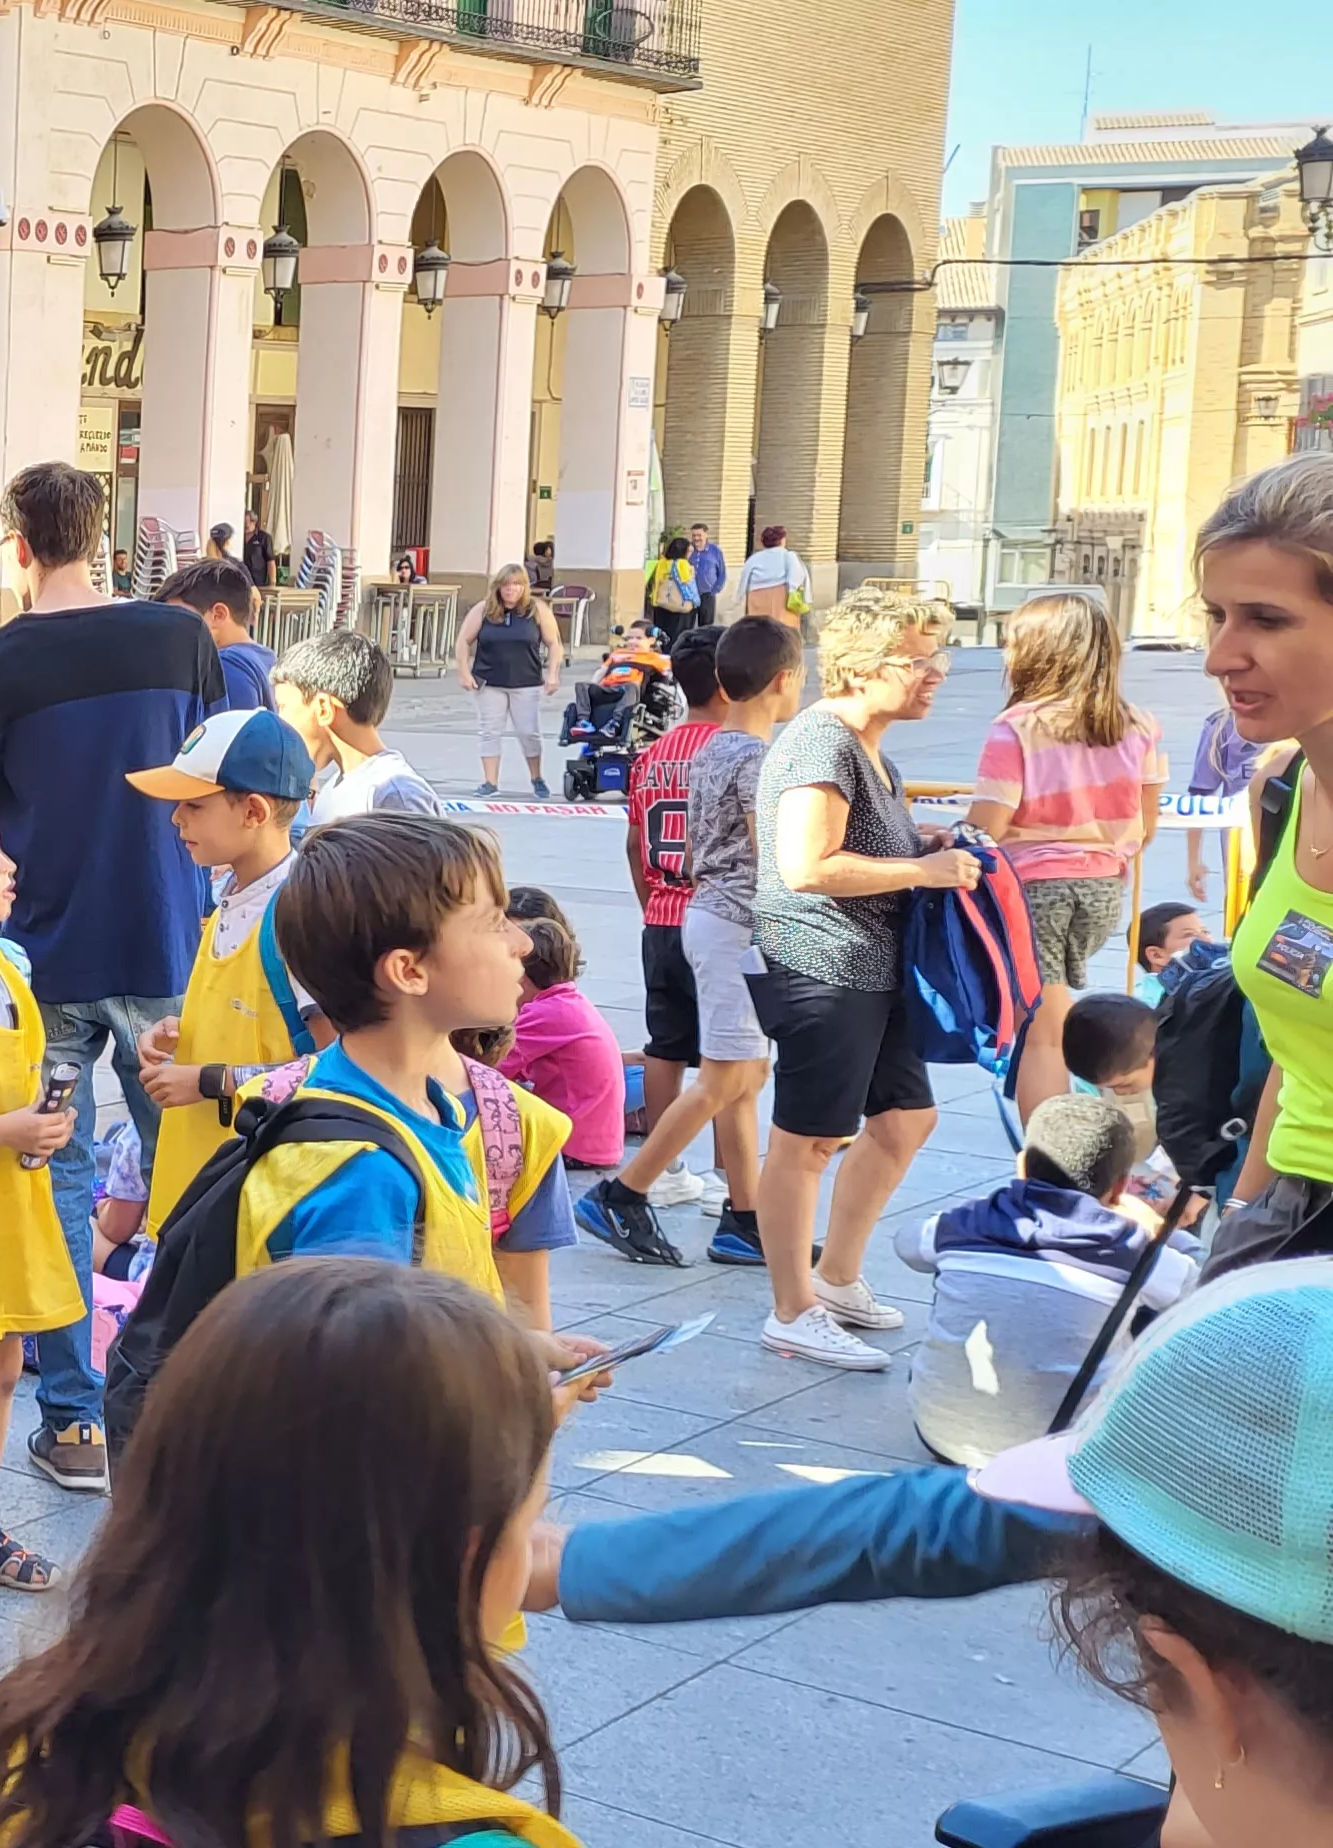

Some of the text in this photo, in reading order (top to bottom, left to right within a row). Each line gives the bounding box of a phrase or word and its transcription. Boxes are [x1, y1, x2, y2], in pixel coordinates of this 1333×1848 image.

[81, 328, 145, 390] nd
[444, 802, 472, 812] IA
[1158, 795, 1234, 816] POLI
